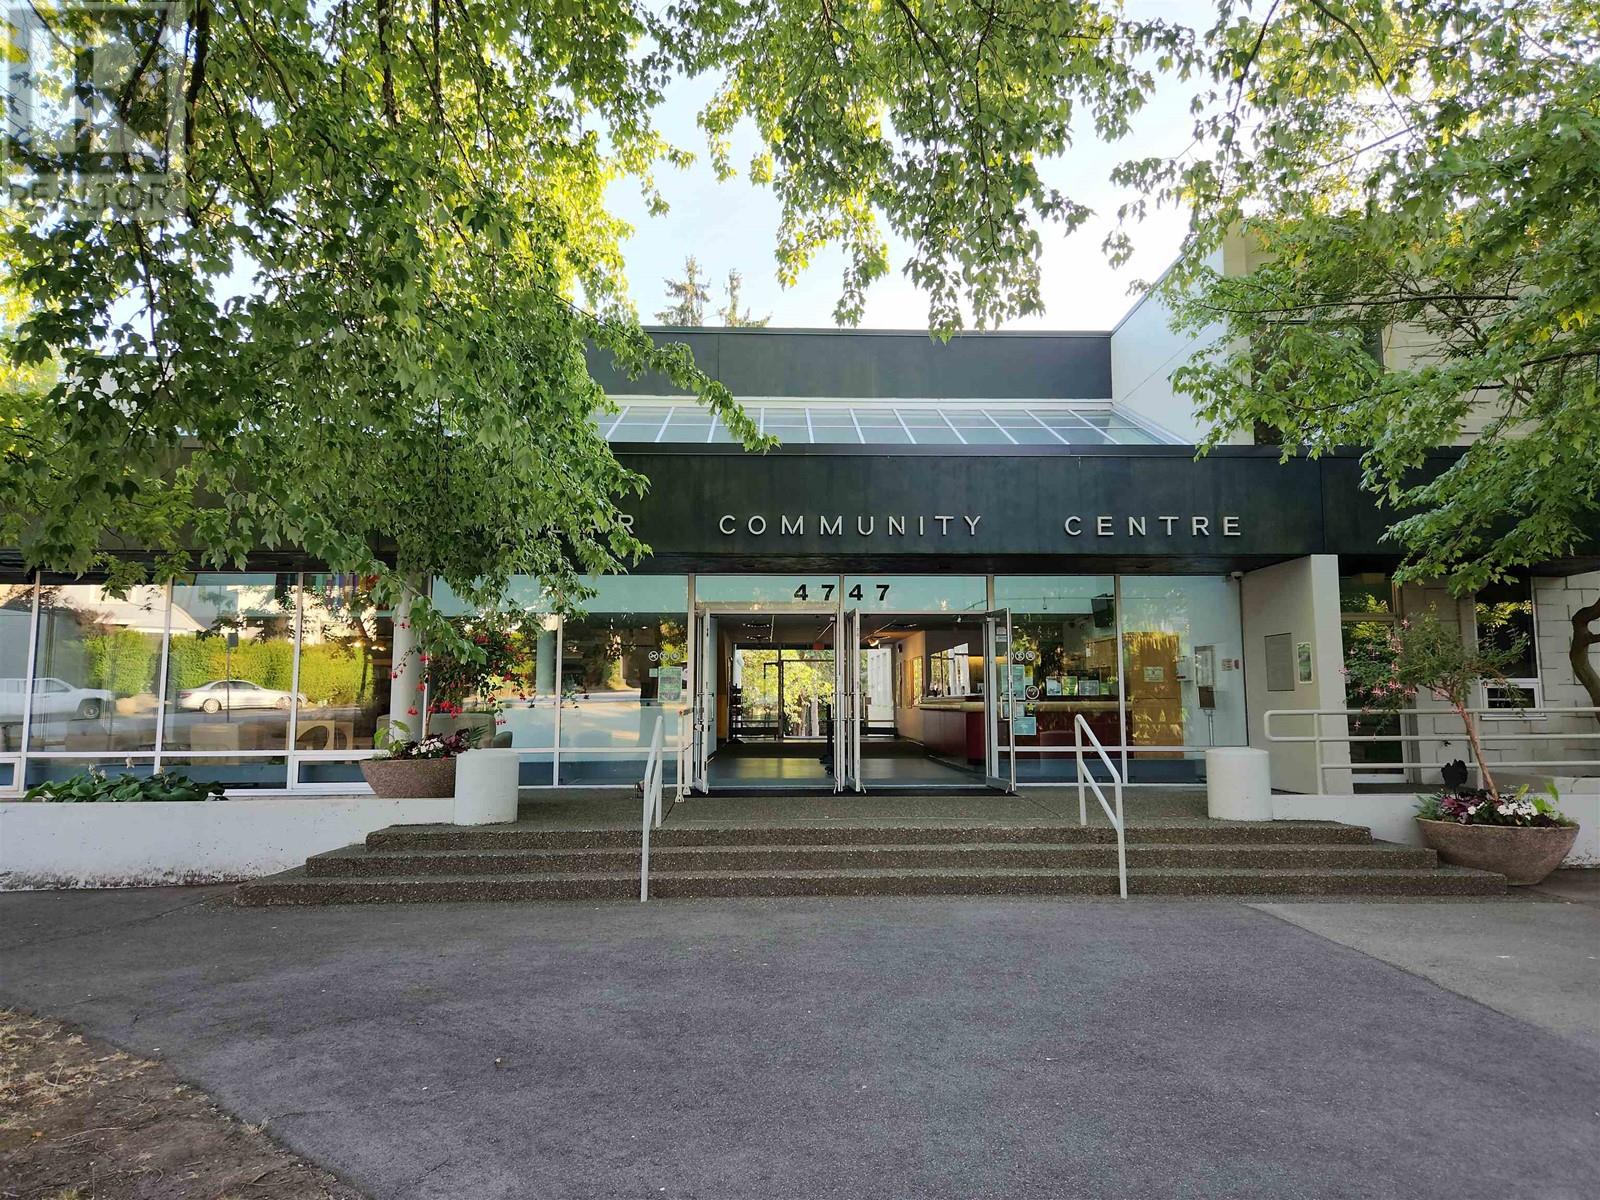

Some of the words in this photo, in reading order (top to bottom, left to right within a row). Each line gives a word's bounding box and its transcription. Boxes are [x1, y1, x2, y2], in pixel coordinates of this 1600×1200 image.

[719, 514, 982, 536] COMMUNITY
[1064, 515, 1242, 536] CENTRE
[793, 584, 891, 602] 4747
